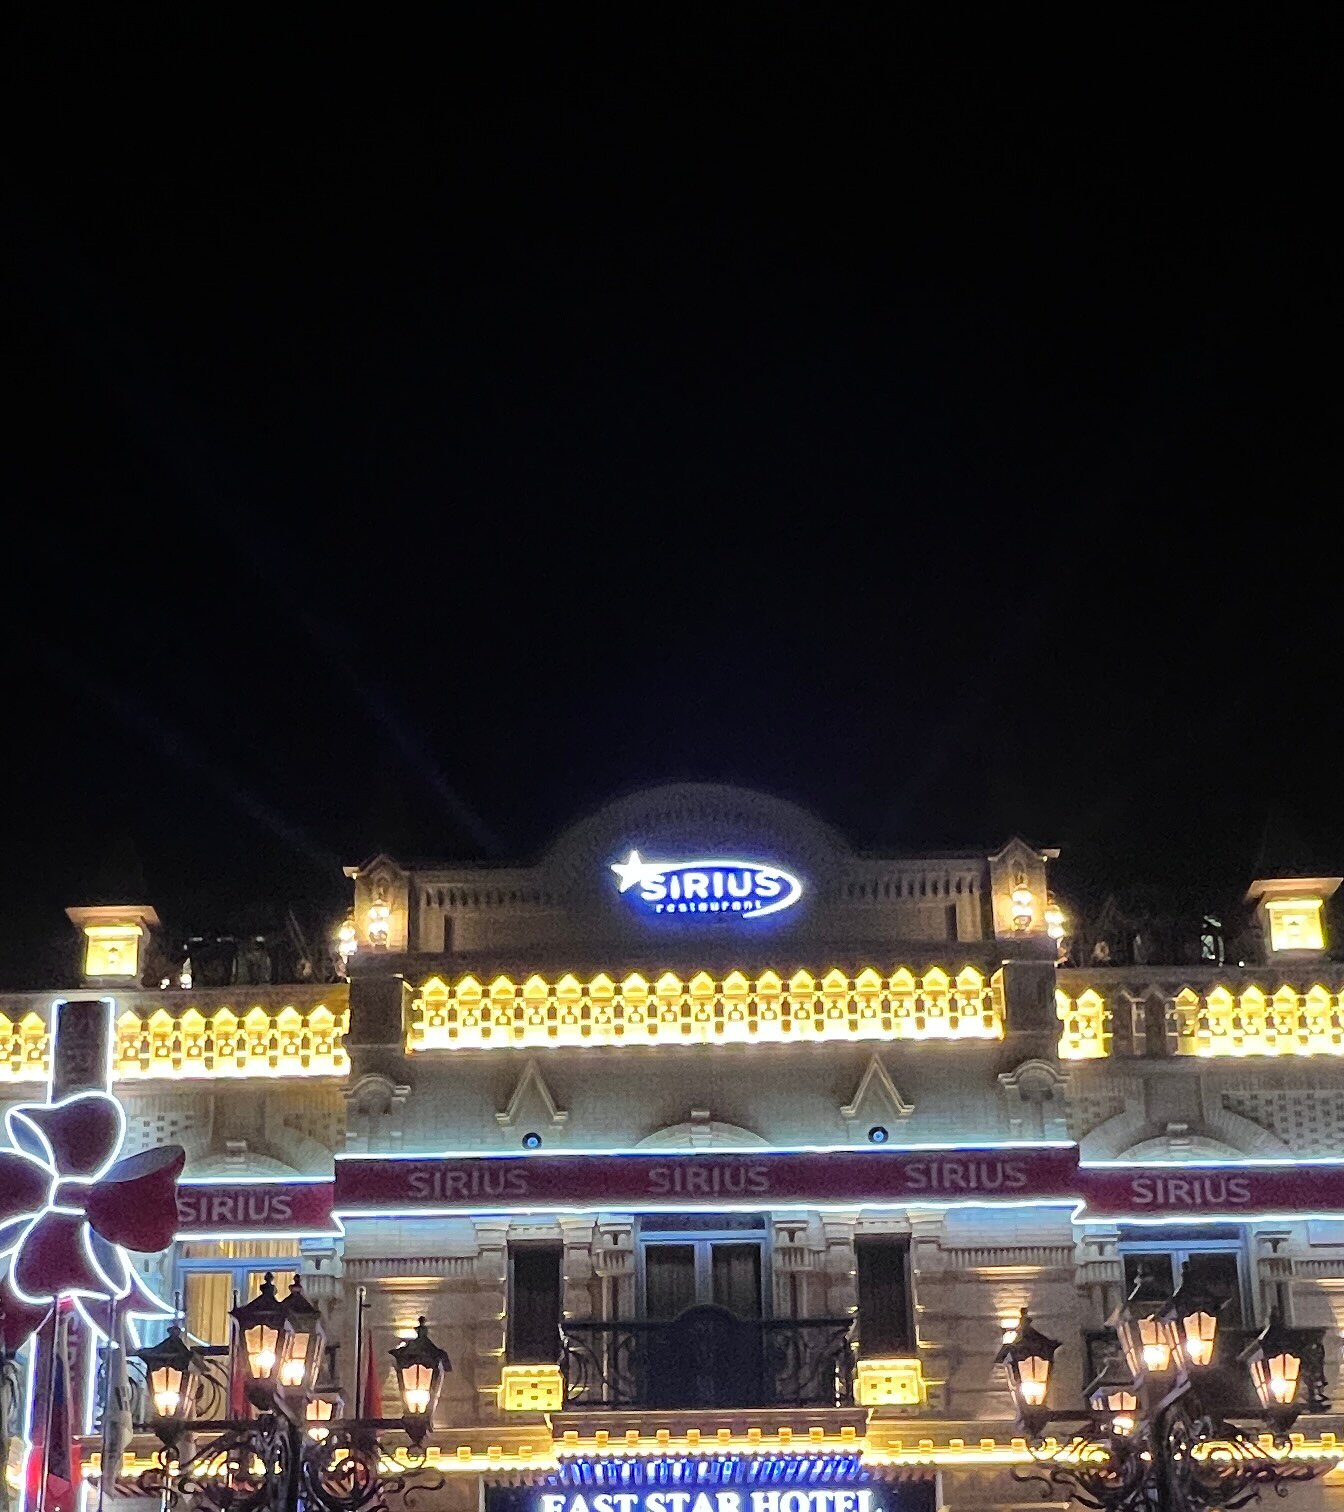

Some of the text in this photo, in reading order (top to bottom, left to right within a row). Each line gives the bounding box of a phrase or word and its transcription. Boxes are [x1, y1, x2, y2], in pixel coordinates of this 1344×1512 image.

[640, 872, 782, 901] SIRIUS
[655, 899, 762, 914] restaurant
[407, 1161, 1027, 1198] SIRIUS SIRIUS SIRIUS
[1131, 1178, 1251, 1204] SIRIUS
[176, 1195, 293, 1222] SIRIUS
